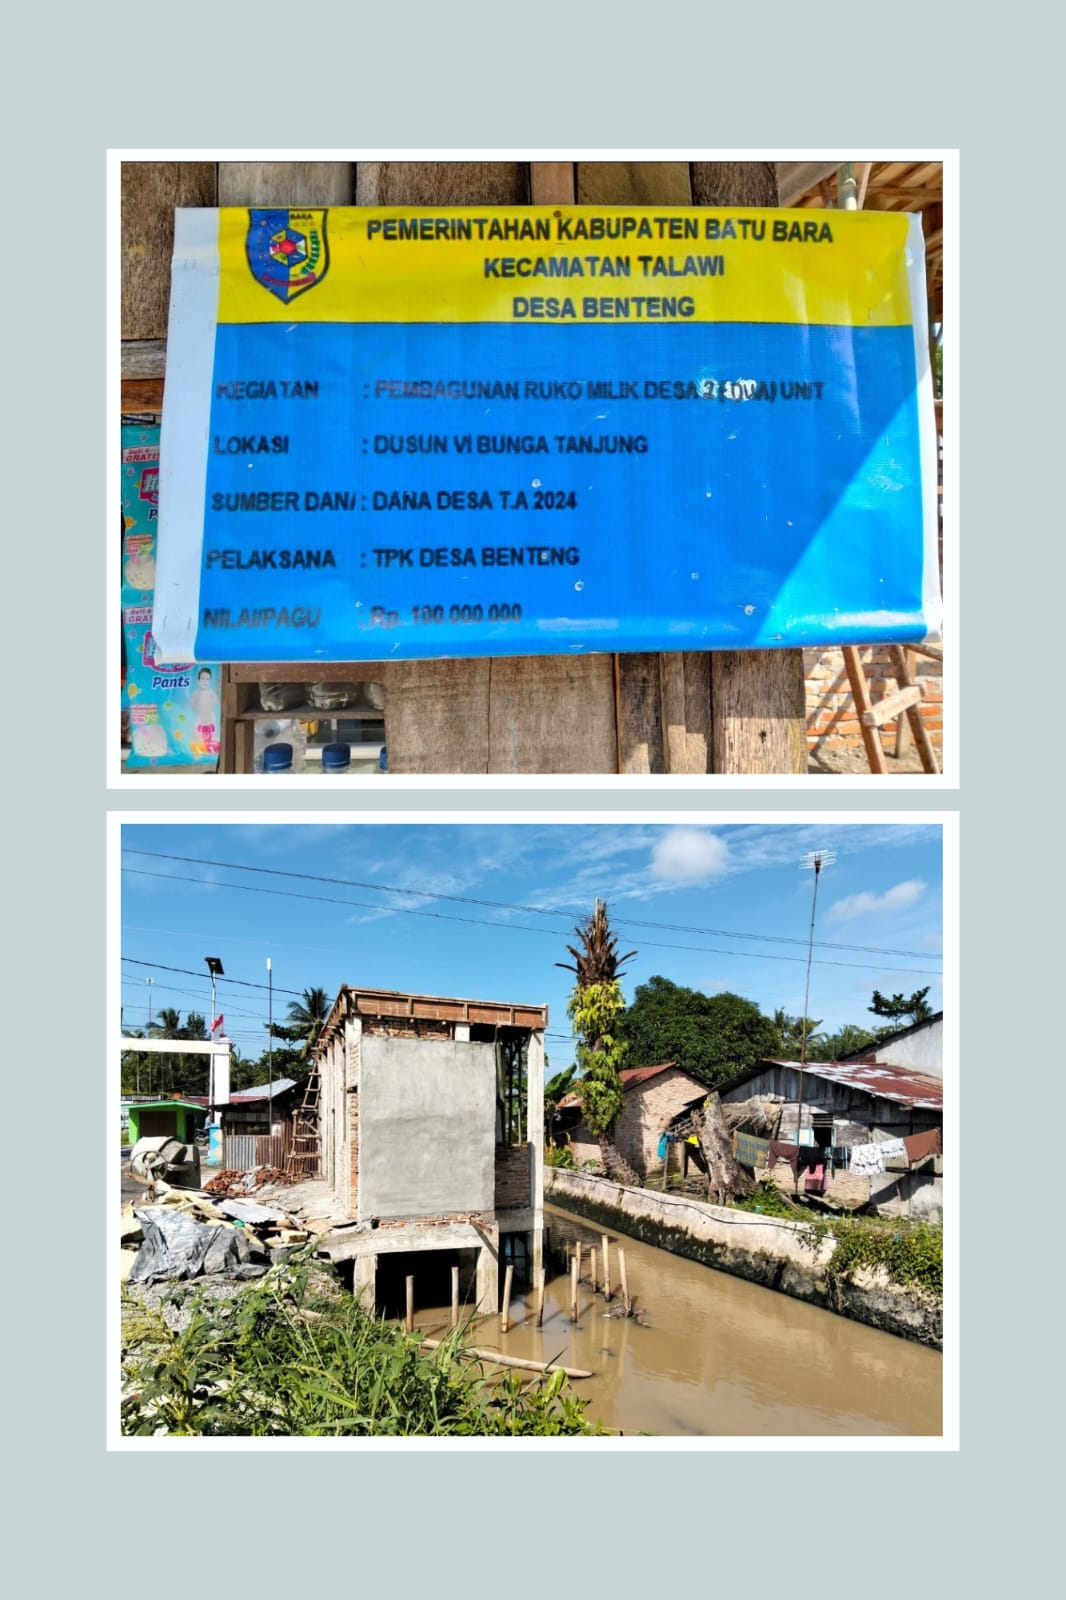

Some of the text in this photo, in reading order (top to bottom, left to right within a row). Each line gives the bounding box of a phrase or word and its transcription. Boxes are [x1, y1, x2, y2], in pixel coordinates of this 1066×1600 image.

[367, 218, 834, 243] PEMERINTAHAN KABUPATEN BATU BARA
[484, 256, 725, 279] KECAMATAN TALAWI
[513, 297, 695, 319] DESA BENTENG
[216, 380, 319, 401] KEGIATAN
[374, 379, 520, 400] PEMBAGUNAN
[524, 380, 582, 400] RUKO
[587, 381, 638, 400] MILIK
[643, 381, 697, 400] DESA
[780, 381, 824, 400] UNIT
[213, 435, 289, 455] LOKASI
[373, 435, 448, 454] DUSUN
[453, 435, 473, 454] VI
[476, 435, 548, 454] BUNGA
[555, 435, 649, 454] TANJUNG
[212, 491, 300, 512] SUMBER
[373, 490, 431, 511] DANA
[437, 490, 493, 511] DESA
[500, 490, 529, 510] T.A
[533, 490, 578, 510] 2024
[206, 548, 337, 570] PELAKSANA
[373, 548, 414, 568] TPK
[420, 548, 476, 567] DESA
[481, 547, 580, 567] BENTENG
[410, 603, 523, 626] 100.000.000
[153, 676, 190, 688] Pants
